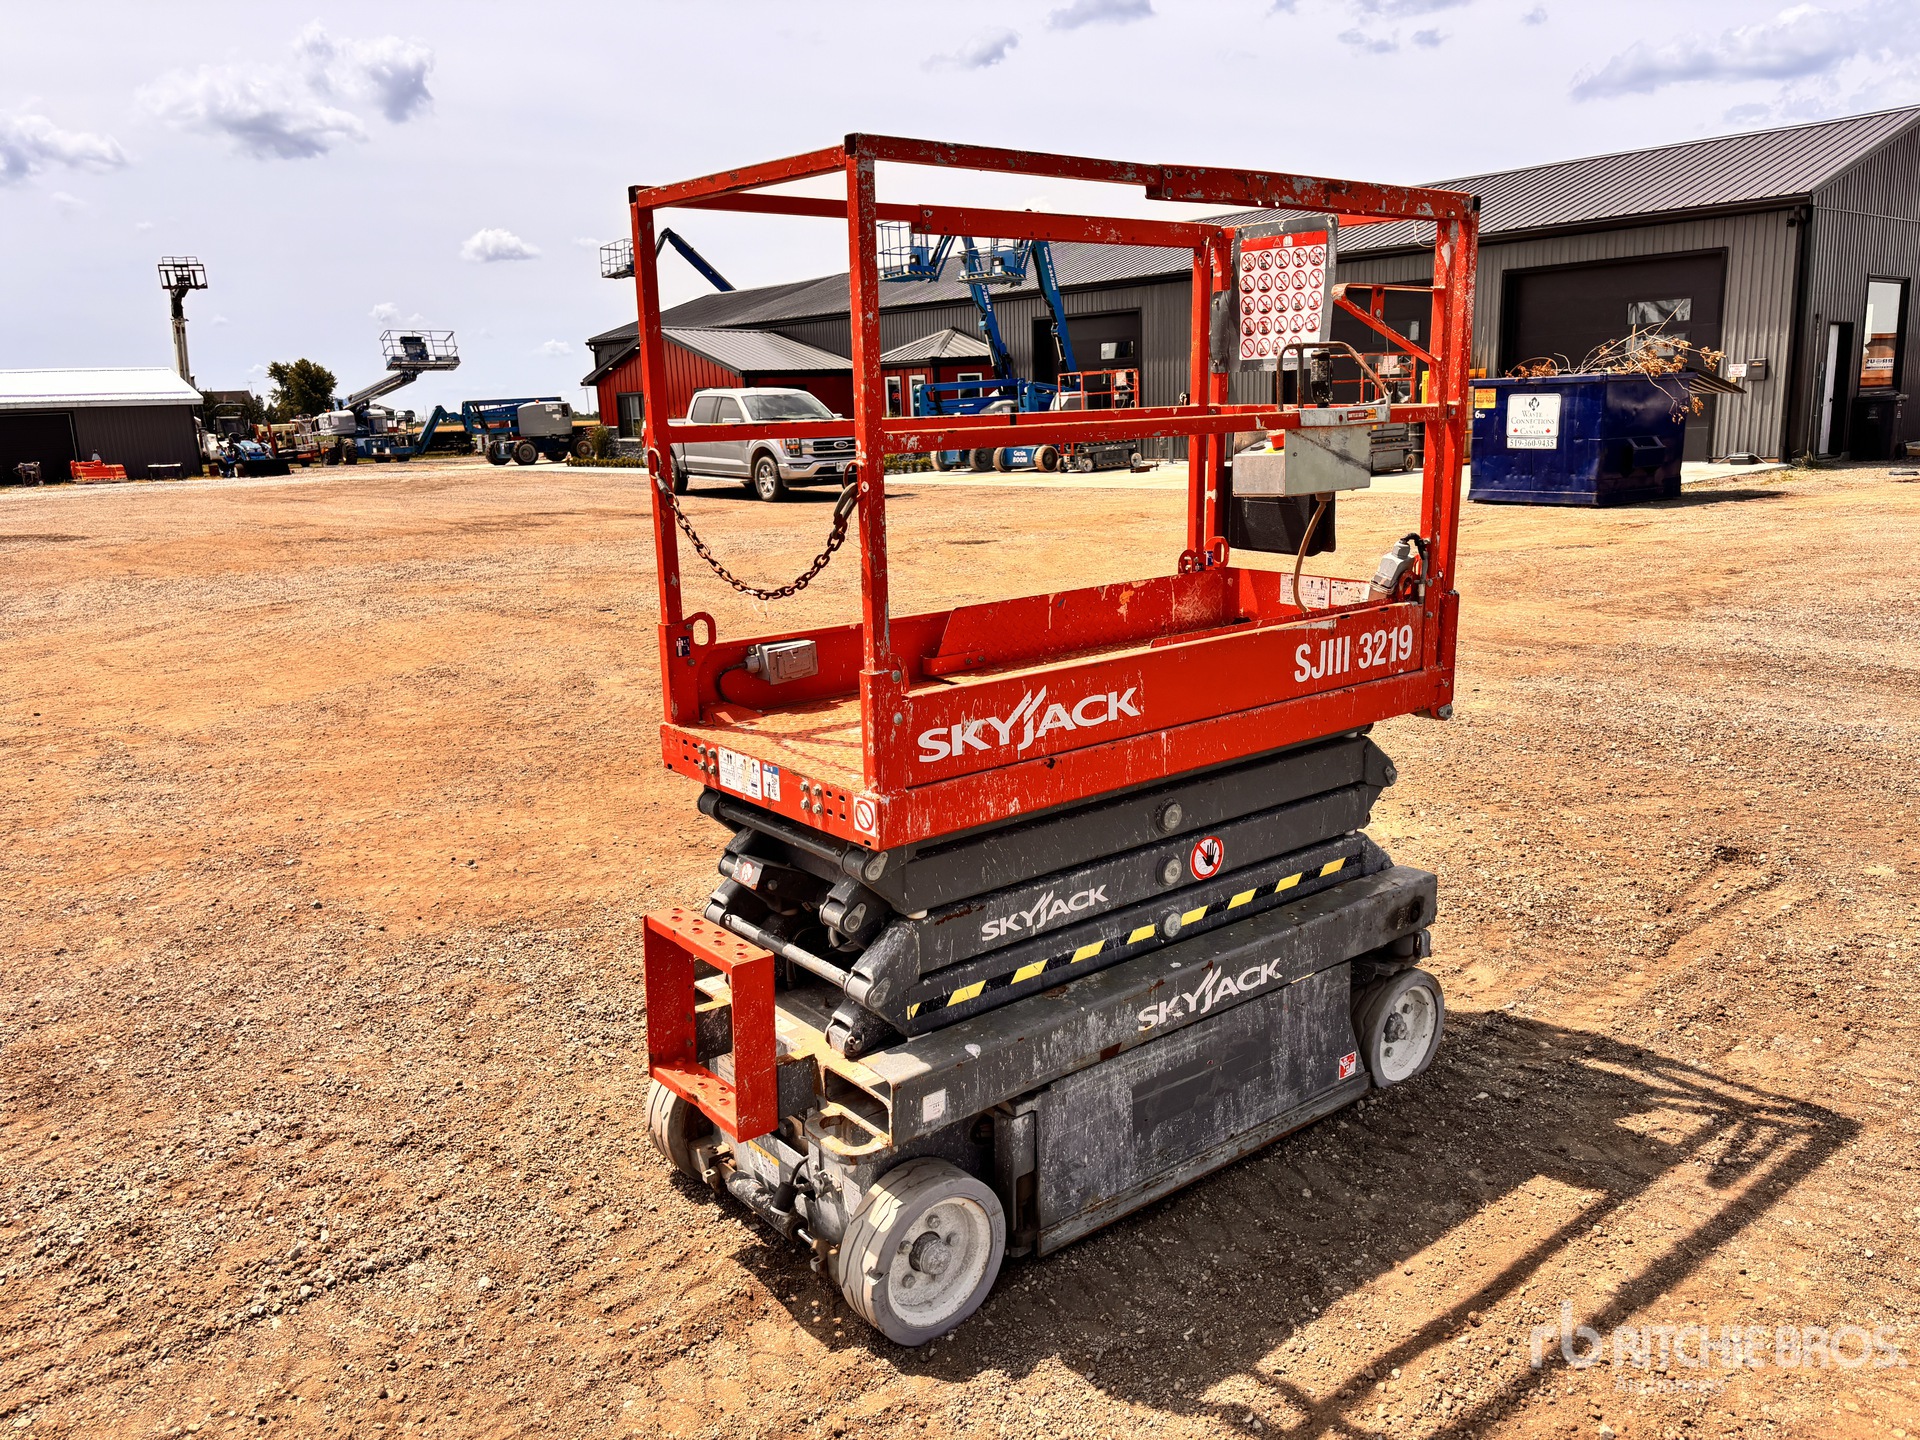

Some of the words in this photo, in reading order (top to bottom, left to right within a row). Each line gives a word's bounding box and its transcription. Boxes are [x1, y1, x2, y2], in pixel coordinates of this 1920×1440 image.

[1294, 635, 1351, 682] SJIII
[1358, 624, 1414, 669] 3219
[918, 685, 1141, 763] SKYJACK
[980, 884, 1109, 942] SKYJACK
[1137, 958, 1283, 1032] SKYJACK
